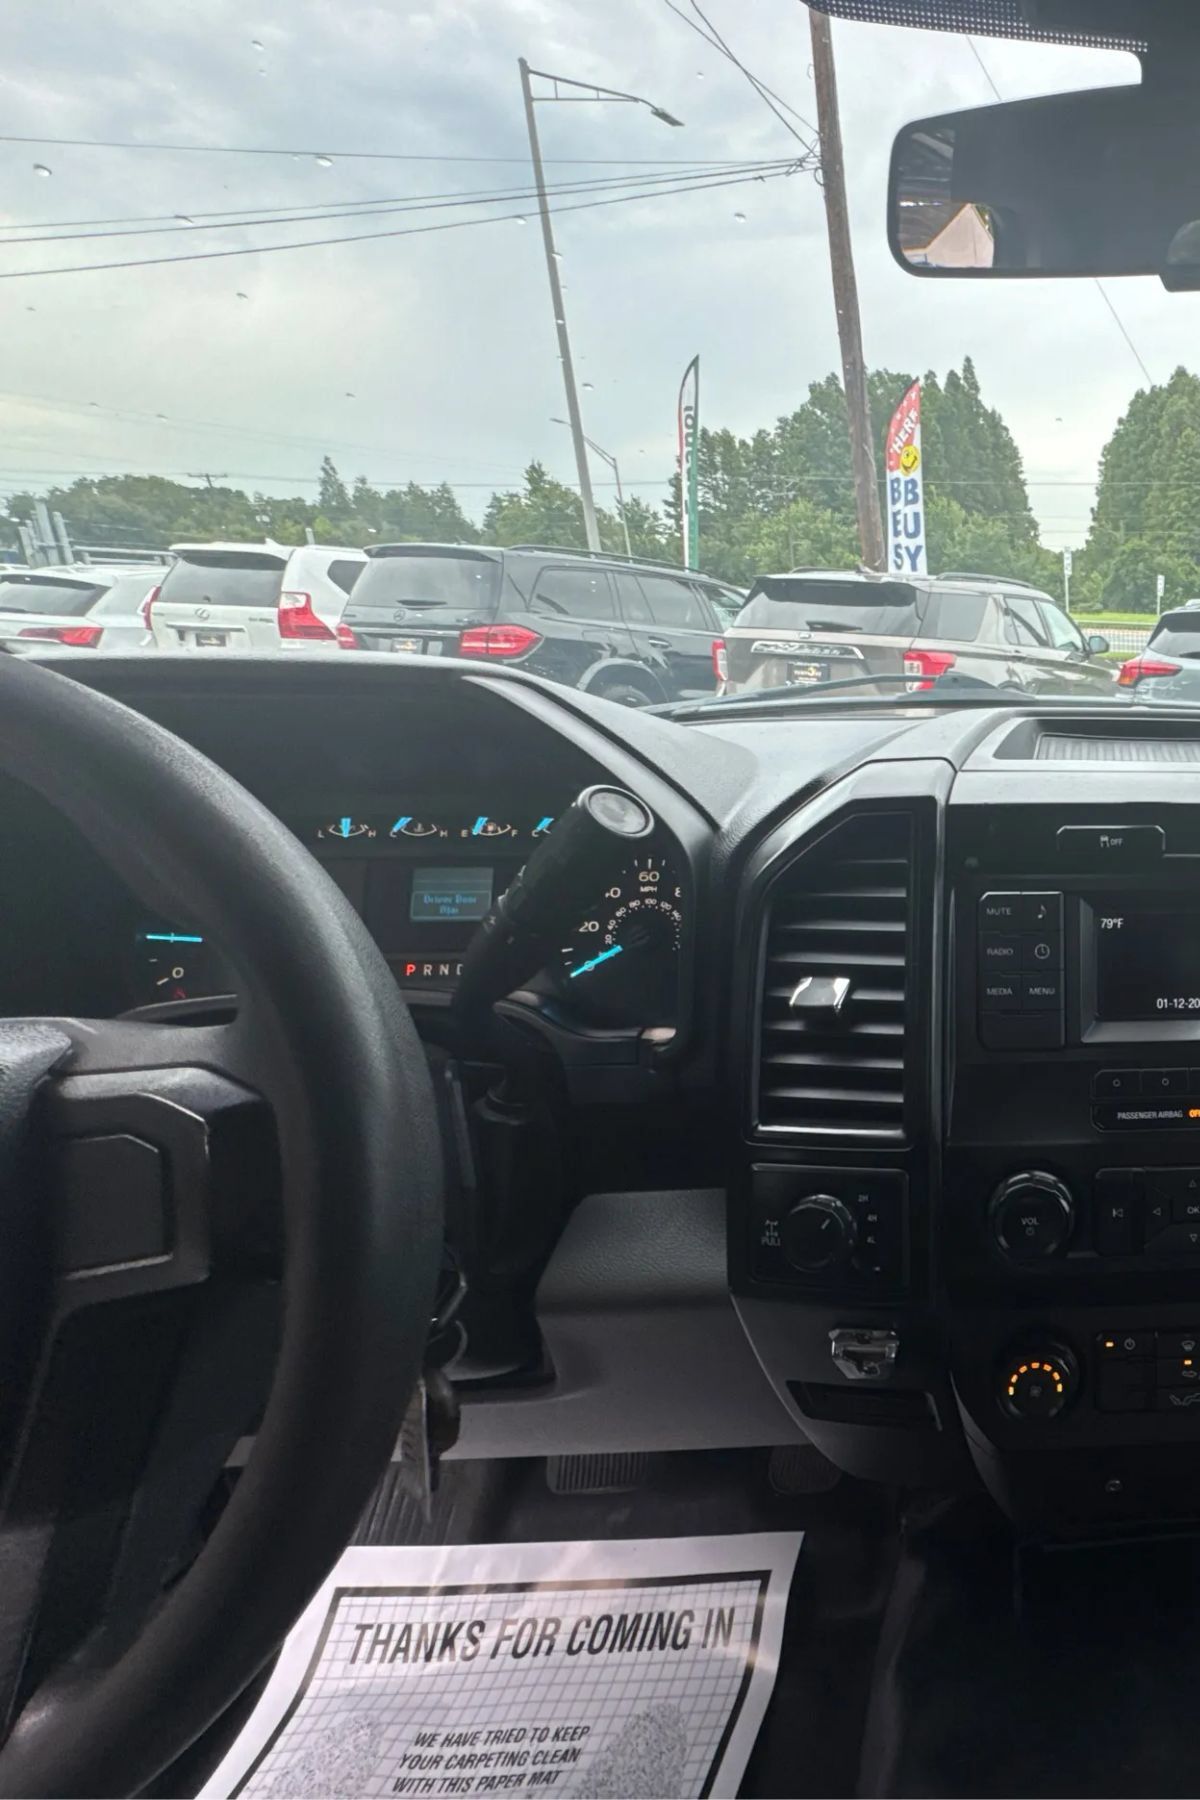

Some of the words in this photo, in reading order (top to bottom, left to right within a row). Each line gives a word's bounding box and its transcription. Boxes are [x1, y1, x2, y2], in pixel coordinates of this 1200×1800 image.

[368, 830, 377, 838] H
[440, 830, 448, 838] H
[461, 830, 468, 838] E
[1110, 837, 1123, 846] OFF
[638, 871, 660, 882] 60
[605, 887, 621, 898] 0
[986, 907, 1012, 916] MUTE
[579, 921, 599, 932] 20
[1100, 917, 1124, 930] 79°F
[986, 948, 1014, 956] RADIO
[171, 967, 184, 979] 0
[406, 963, 416, 976] P
[423, 964, 433, 976] R
[439, 964, 449, 976] N
[986, 987, 1013, 996] MEDIA
[1028, 987, 1055, 996] MENU
[1117, 1111, 1157, 1120] PASSENGER
[1158, 1109, 1183, 1119] AIRBAG
[1187, 1206, 1200, 1215] OK
[1020, 1217, 1040, 1226] VOL
[349, 1620, 486, 1665] THANKS
[490, 1615, 562, 1659] FOR
[567, 1609, 694, 1656] COMING
[701, 1607, 735, 1649] IN
[414, 1732, 441, 1747] WE
[440, 1731, 482, 1747] HAVE
[482, 1728, 527, 1744] TRIED
[529, 1727, 550, 1743] TO
[552, 1726, 590, 1742] KEEP
[400, 1754, 444, 1770] YOUR
[444, 1751, 529, 1770] CARPETING
[532, 1748, 581, 1766] CLEAN
[392, 1777, 437, 1793] WITH
[437, 1776, 475, 1793] THIS
[475, 1774, 525, 1791] PAPER
[527, 1770, 562, 1786] MAT
